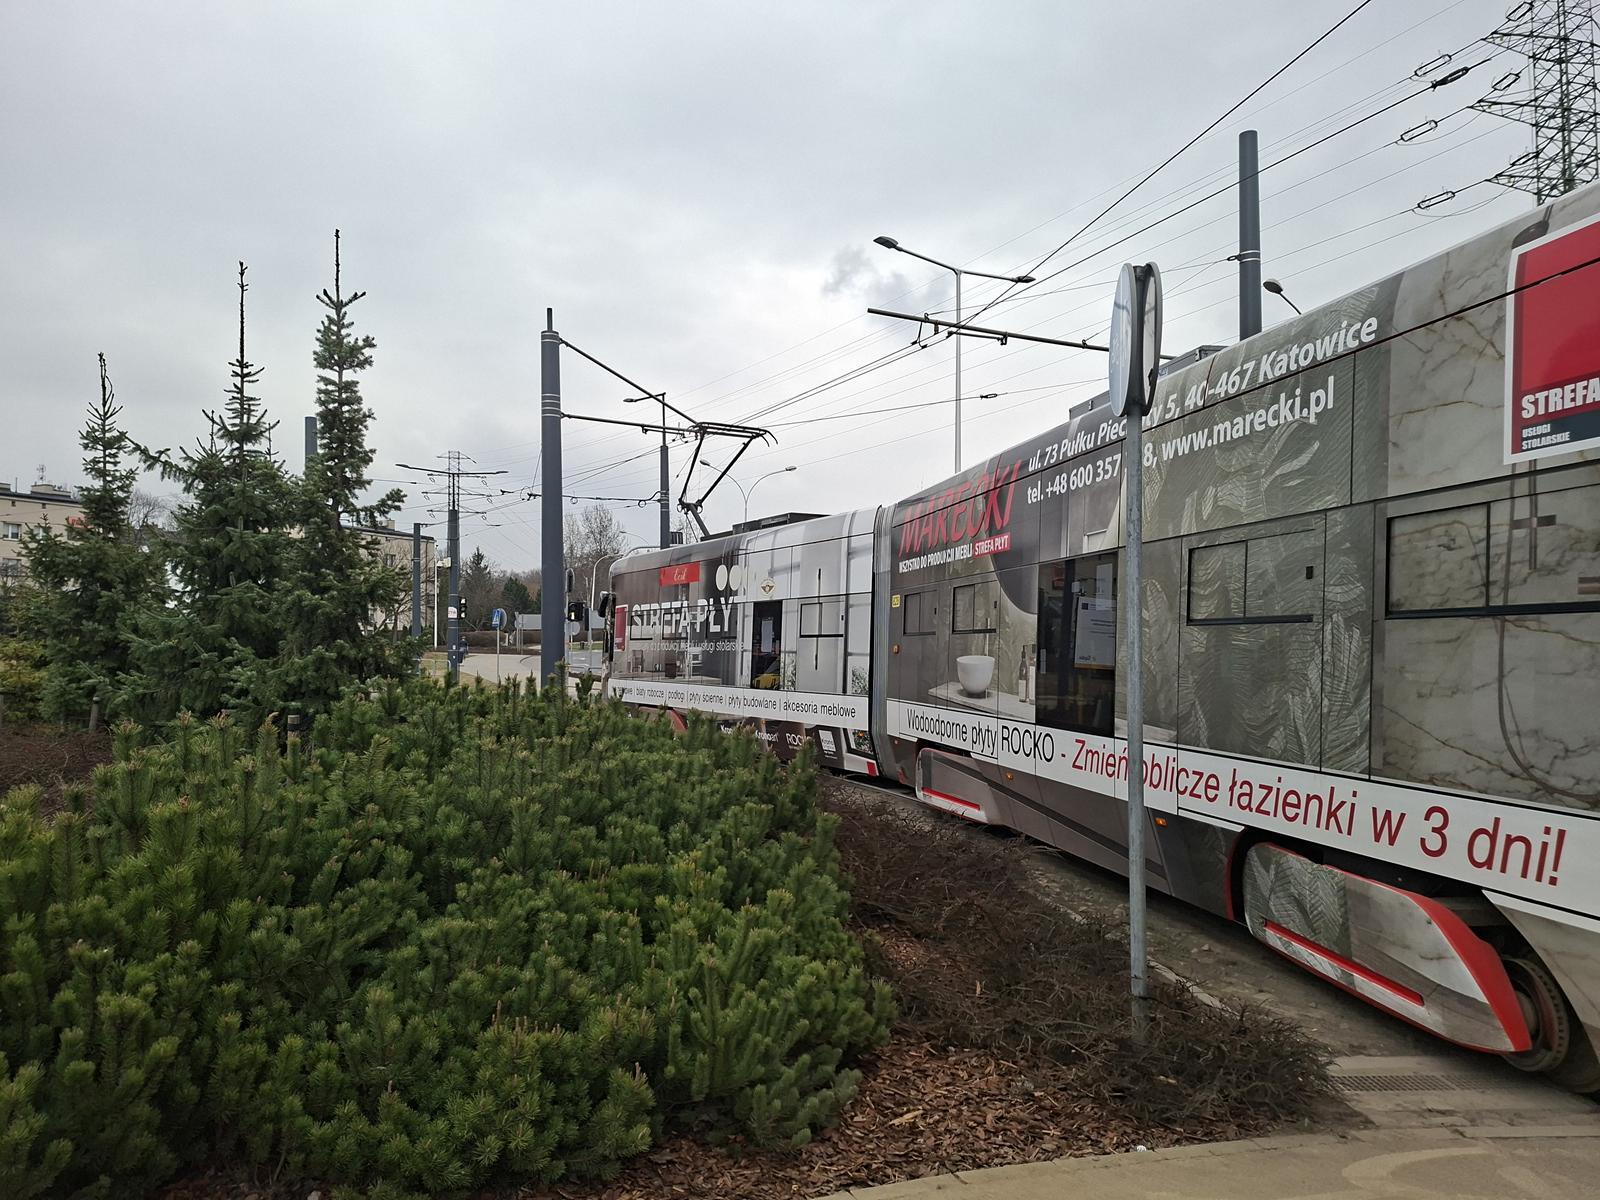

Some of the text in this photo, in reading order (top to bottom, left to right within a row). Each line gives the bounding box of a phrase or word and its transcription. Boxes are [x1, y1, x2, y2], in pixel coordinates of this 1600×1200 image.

[1028, 449, 1042, 472] ul.
[1044, 444, 1058, 466] 73
[1060, 430, 1095, 460] Pułku
[1165, 393, 1181, 420] 5,
[1185, 361, 1255, 410] 40-467
[1259, 317, 1378, 383] Katowice
[1522, 377, 1600, 419] STREFA
[1027, 480, 1044, 505] tel.
[1046, 473, 1067, 498] +48
[1070, 464, 1093, 491] 600
[1096, 453, 1121, 482] 357
[1161, 375, 1334, 461] www.marecki.pl
[1522, 431, 1570, 450] STOLARSKIE
[899, 457, 1022, 558] MARECKI
[954, 543, 972, 561] MEBLI
[975, 538, 994, 556] STREFA
[631, 600, 690, 634] STREFA
[743, 695, 777, 710] budowlane
[783, 700, 818, 714] akcesoria
[820, 703, 856, 718] meblowe
[907, 708, 968, 743] Wodoodporne
[971, 720, 997, 755] płyty
[1001, 724, 1055, 763] ROCKO
[1072, 738, 1128, 782] Zmień
[1229, 768, 1357, 836] łazienki
[1371, 806, 1407, 847] w
[1420, 805, 1450, 858] 3
[1467, 816, 1566, 887] dni!
